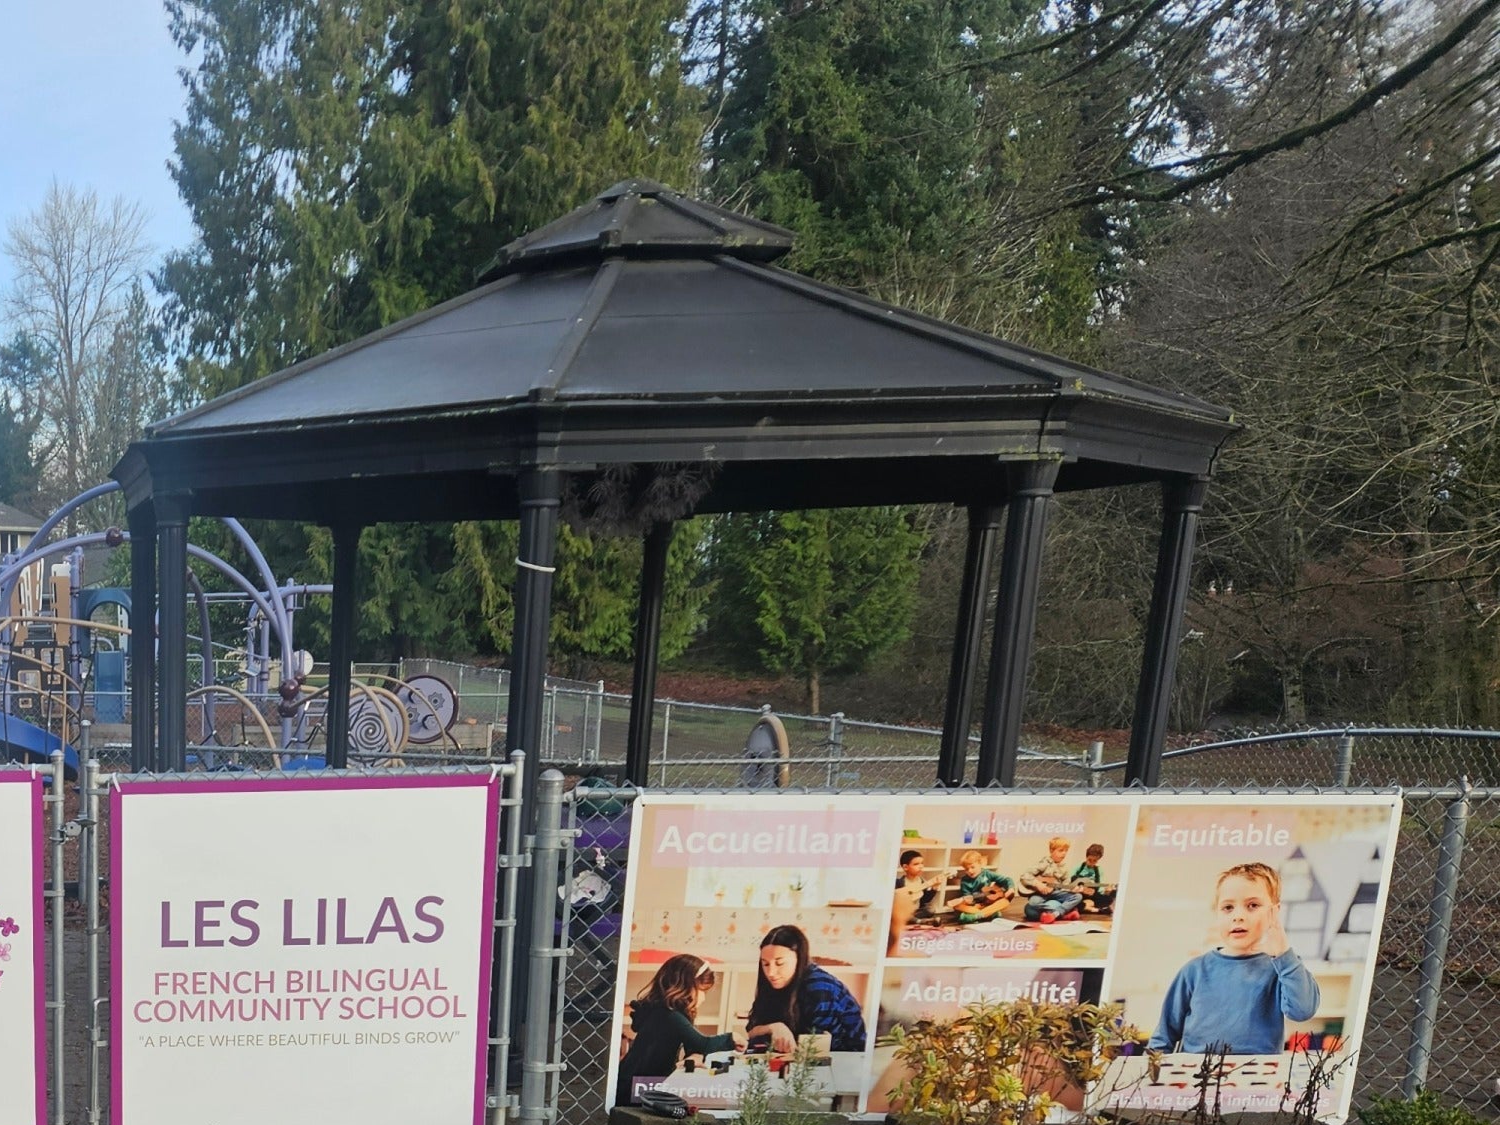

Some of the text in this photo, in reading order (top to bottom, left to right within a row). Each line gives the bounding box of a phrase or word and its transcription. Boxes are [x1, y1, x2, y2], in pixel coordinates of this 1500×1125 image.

[657, 824, 872, 854] Accueillant
[963, 819, 1085, 833] Multi-Niveaux
[1153, 823, 1290, 852] Equitable
[161, 896, 445, 948] LES LILAS
[959, 937, 1034, 951] Flexibles
[155, 967, 448, 995] FRENCH BILINGUAL
[902, 980, 1077, 1008] Adaptabilité
[133, 995, 467, 1023] COMMUNITY SCHOOL
[159, 1035, 204, 1048] PLACE
[209, 1034, 264, 1047] WHERE
[268, 1032, 350, 1047] BEAUTIFUL
[355, 1032, 401, 1045] BINDS
